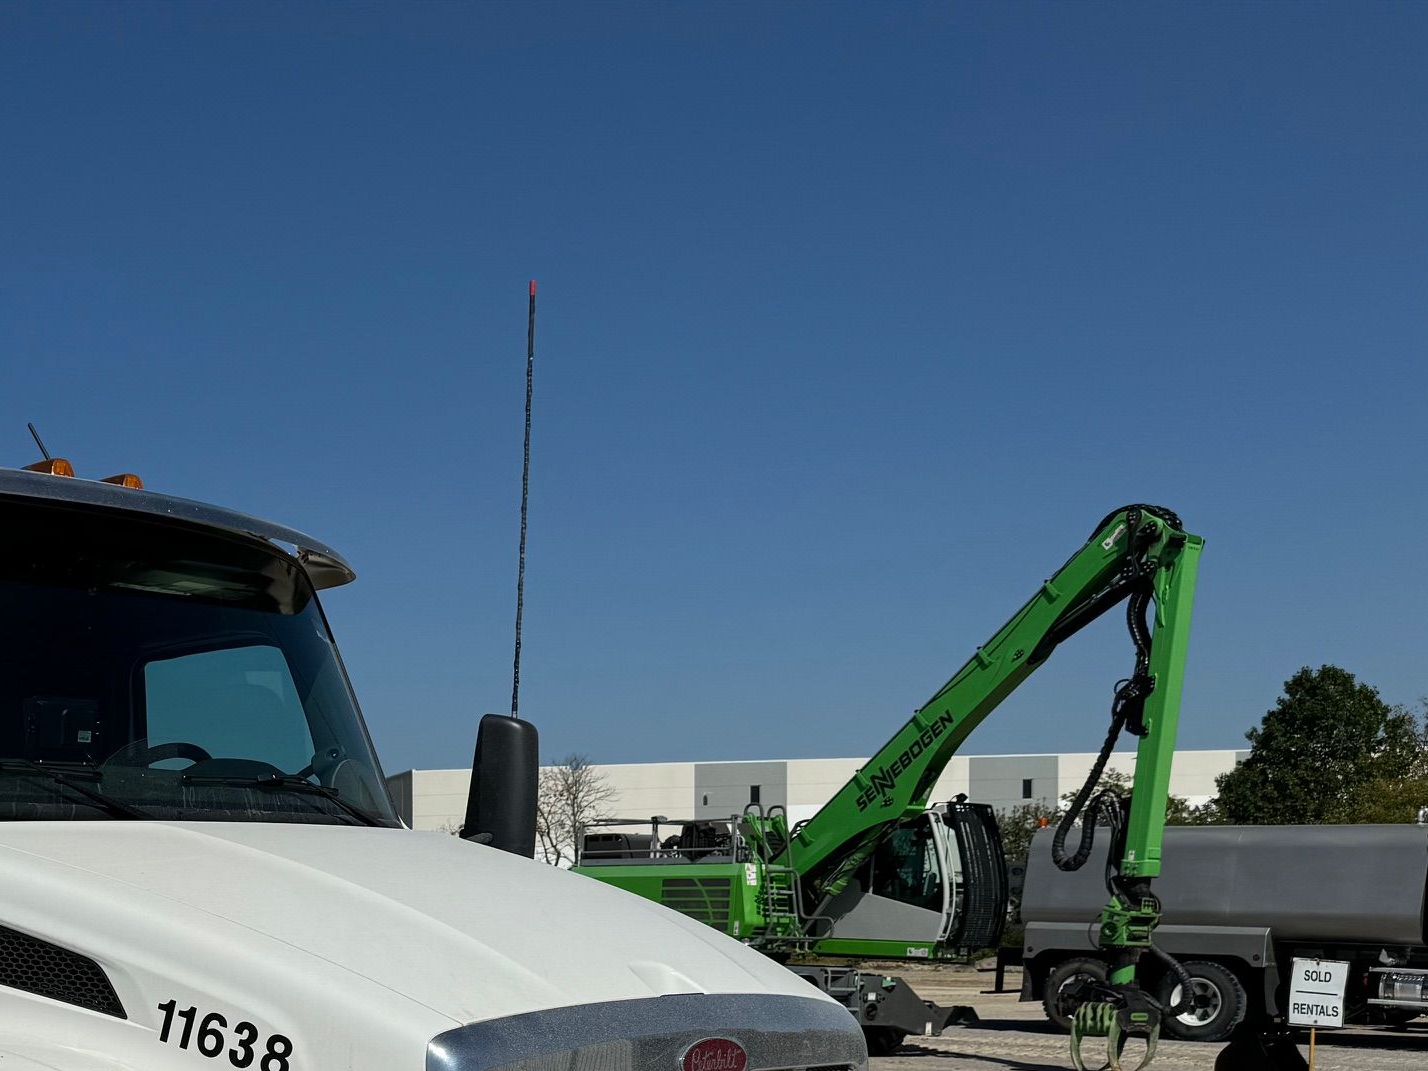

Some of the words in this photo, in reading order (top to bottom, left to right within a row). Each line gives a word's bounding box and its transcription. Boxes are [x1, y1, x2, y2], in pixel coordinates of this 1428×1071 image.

[855, 710, 955, 812] SENNEBOGEN
[1303, 969, 1332, 983] SOLD
[1292, 1002, 1339, 1018] RENTALS
